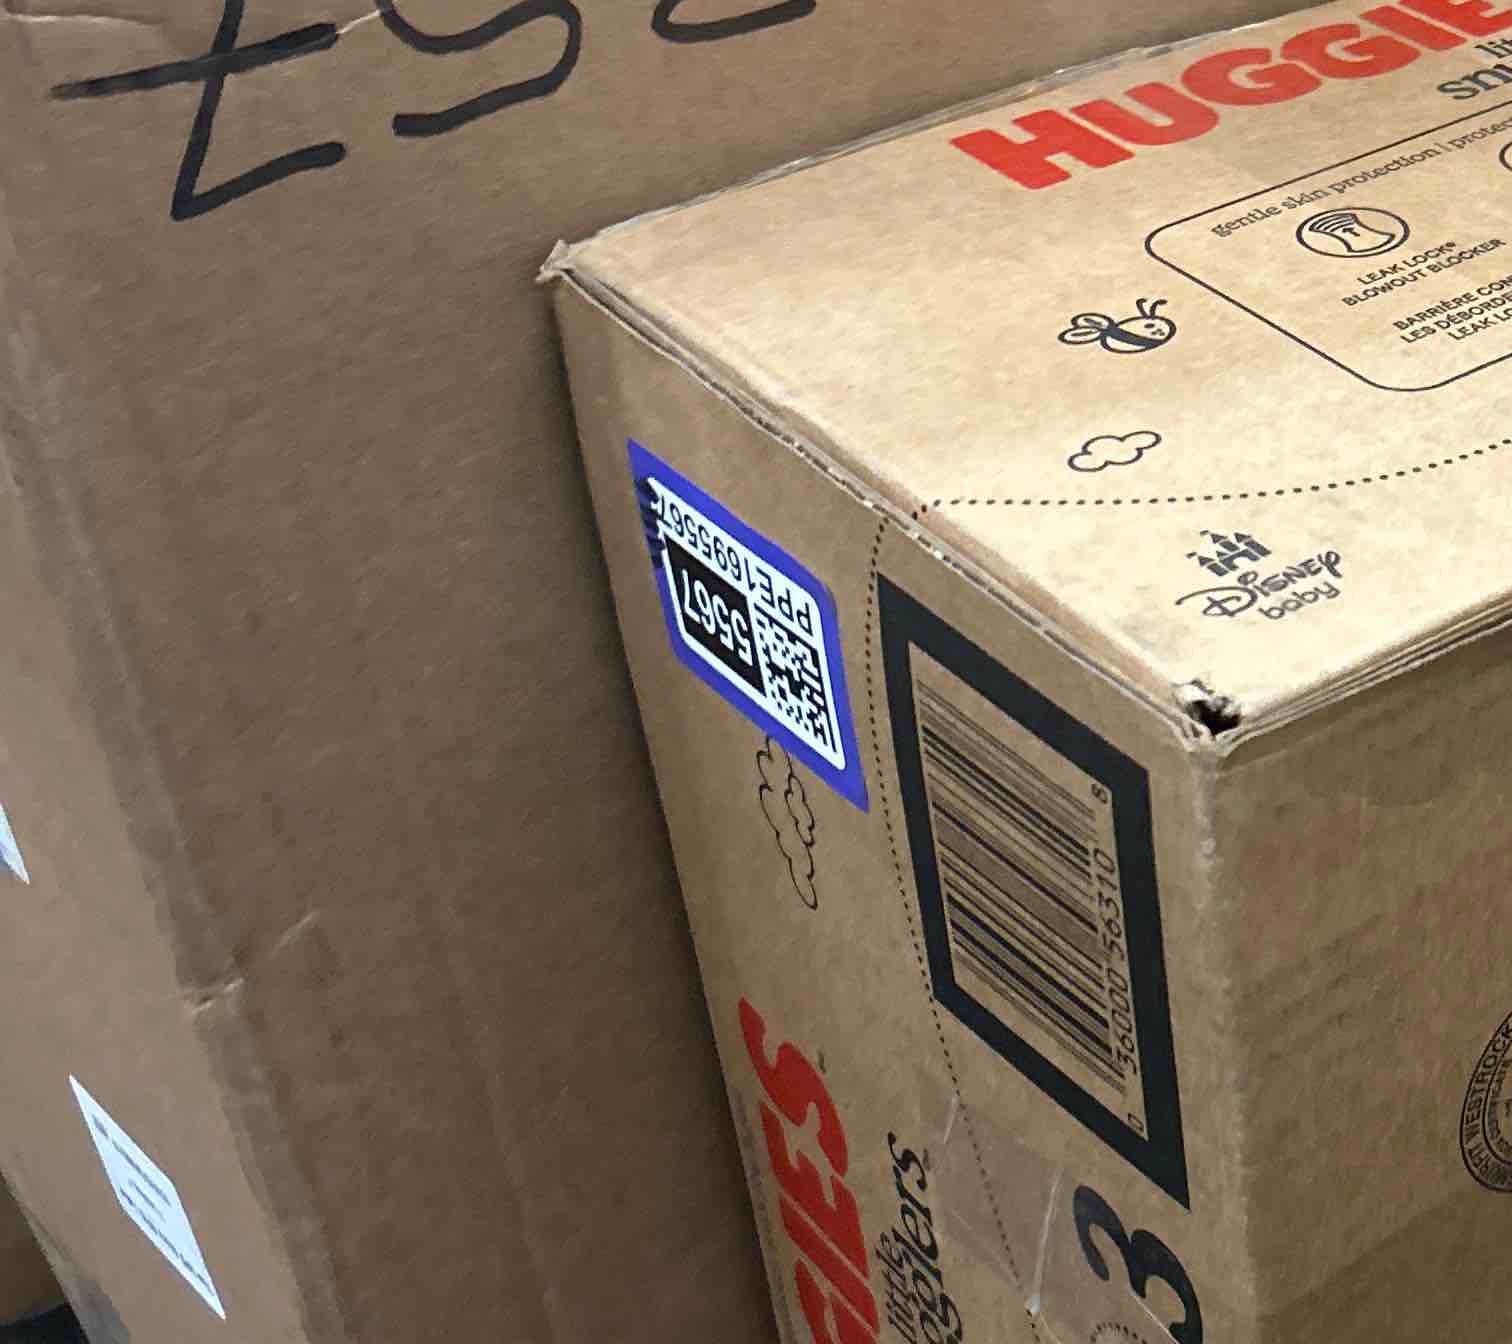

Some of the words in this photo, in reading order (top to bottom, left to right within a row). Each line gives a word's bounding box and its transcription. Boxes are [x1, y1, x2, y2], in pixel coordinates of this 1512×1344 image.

[1210, 206, 1283, 238] gentle
[1281, 189, 1332, 210] skin
[1327, 148, 1443, 194] protection
[1341, 268, 1427, 306] BLOWOUT
[1425, 238, 1507, 273] BLOCKER
[1356, 263, 1406, 285] LEAK
[1392, 292, 1479, 331] BARRIÈRE
[1399, 325, 1437, 344] LES
[1447, 316, 1498, 341] LEAK
[656, 494, 814, 637] PPE1695567
[1175, 549, 1342, 617] Disney
[681, 567, 753, 667] 5567
[1258, 581, 1341, 620] baby
[1093, 847, 1126, 962] 56310
[1108, 967, 1137, 1075] 36000
[1127, 1112, 1144, 1132] 0
